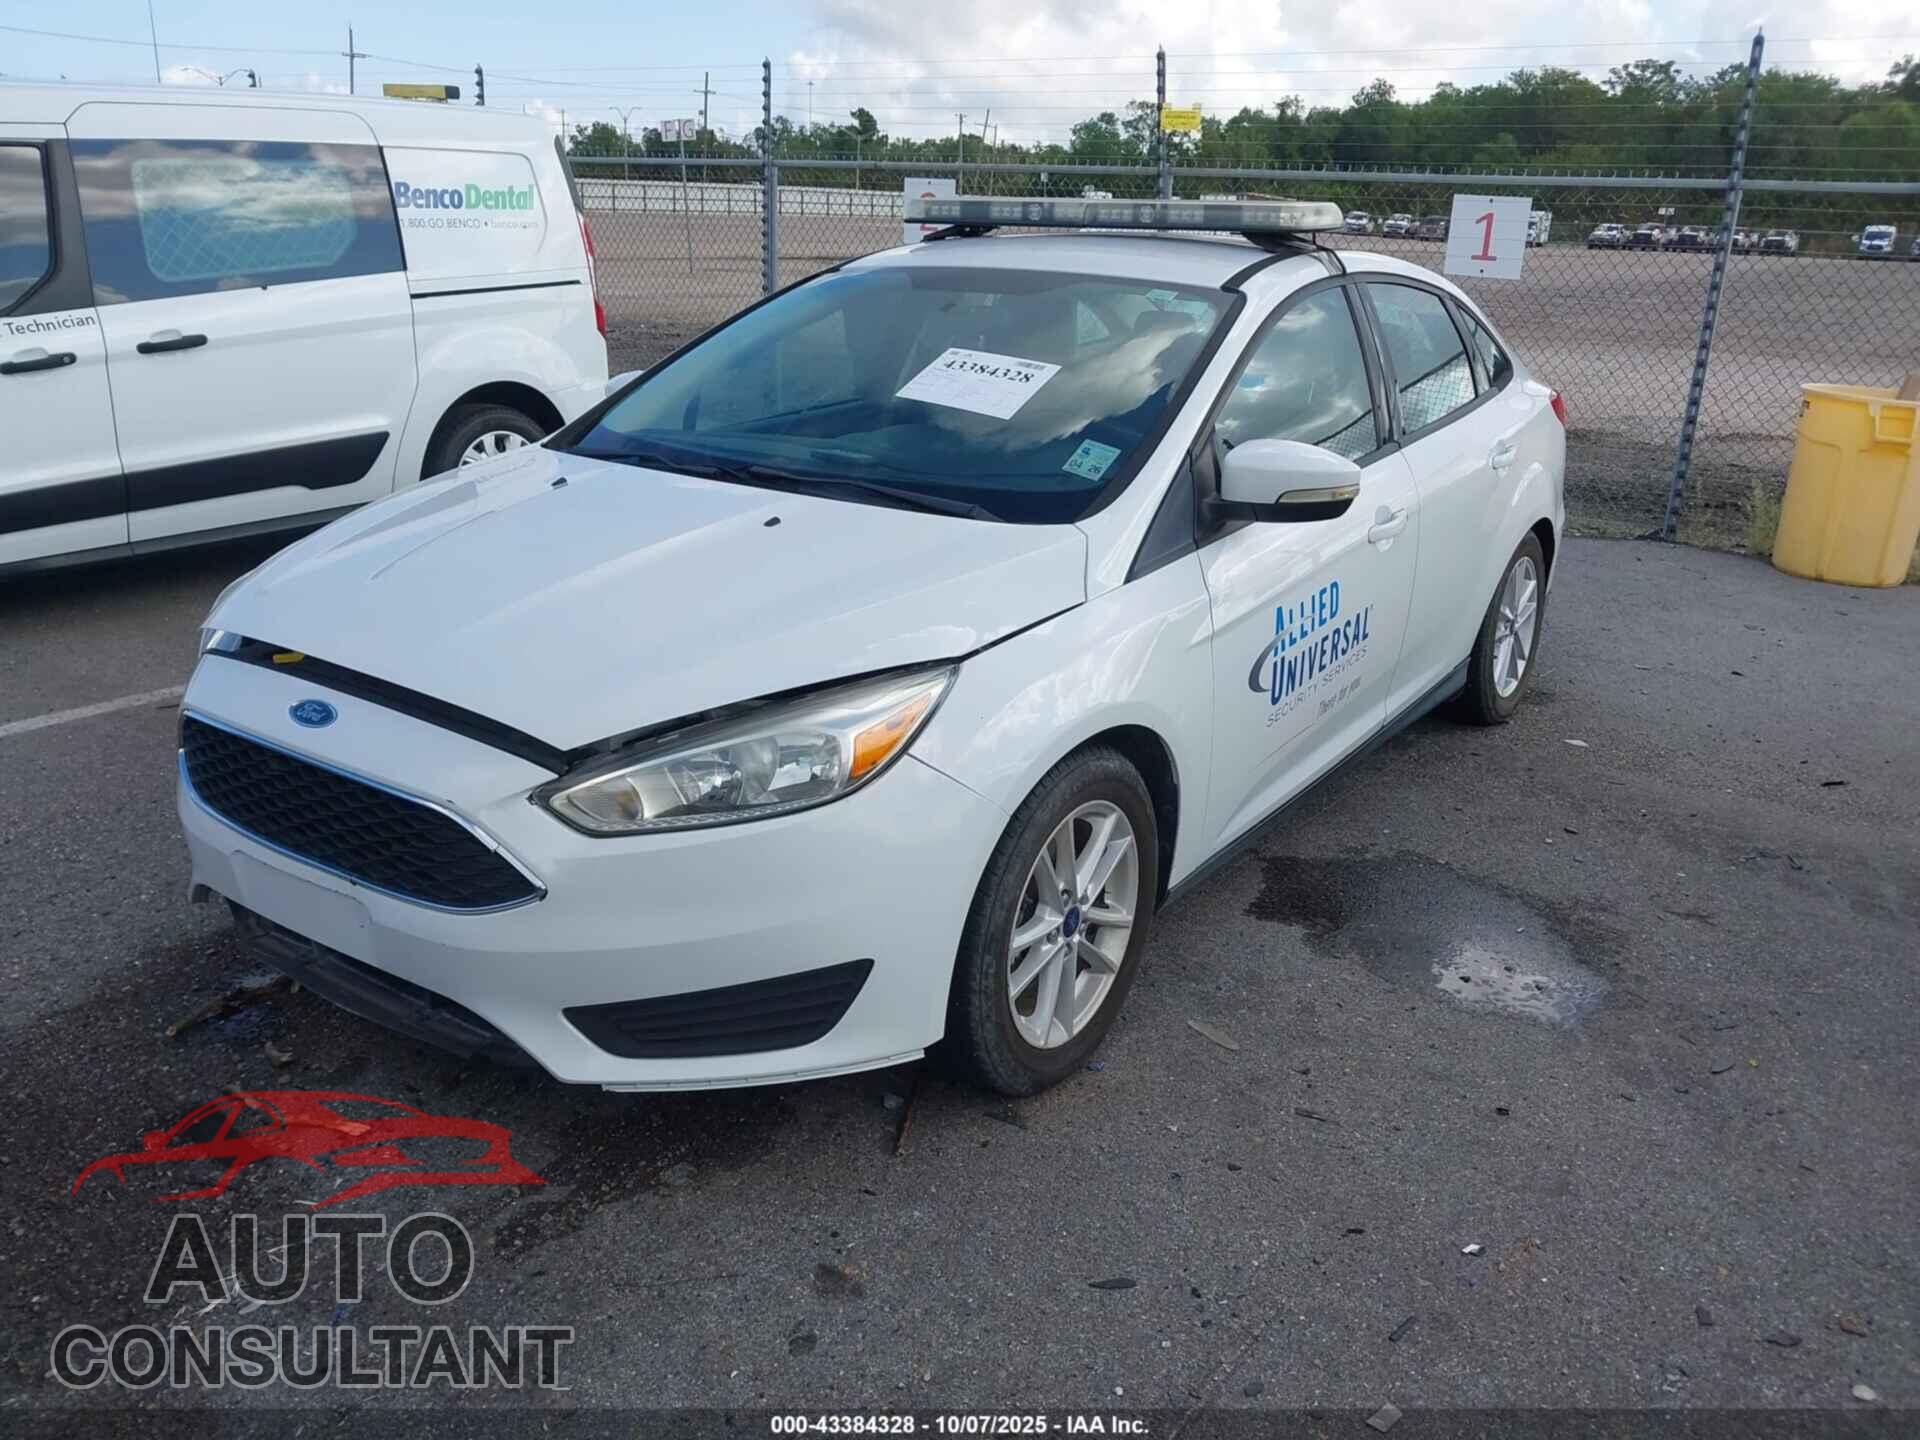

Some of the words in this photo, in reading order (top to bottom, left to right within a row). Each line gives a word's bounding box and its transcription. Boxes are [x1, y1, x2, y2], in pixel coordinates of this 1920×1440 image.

[682, 119, 694, 138] G
[1471, 212, 1497, 261] 1
[3, 314, 96, 335] Technician
[943, 360, 1035, 383] 43384328
[1273, 581, 1340, 657] ALLIED
[1270, 607, 1369, 706] UNIVERSAL
